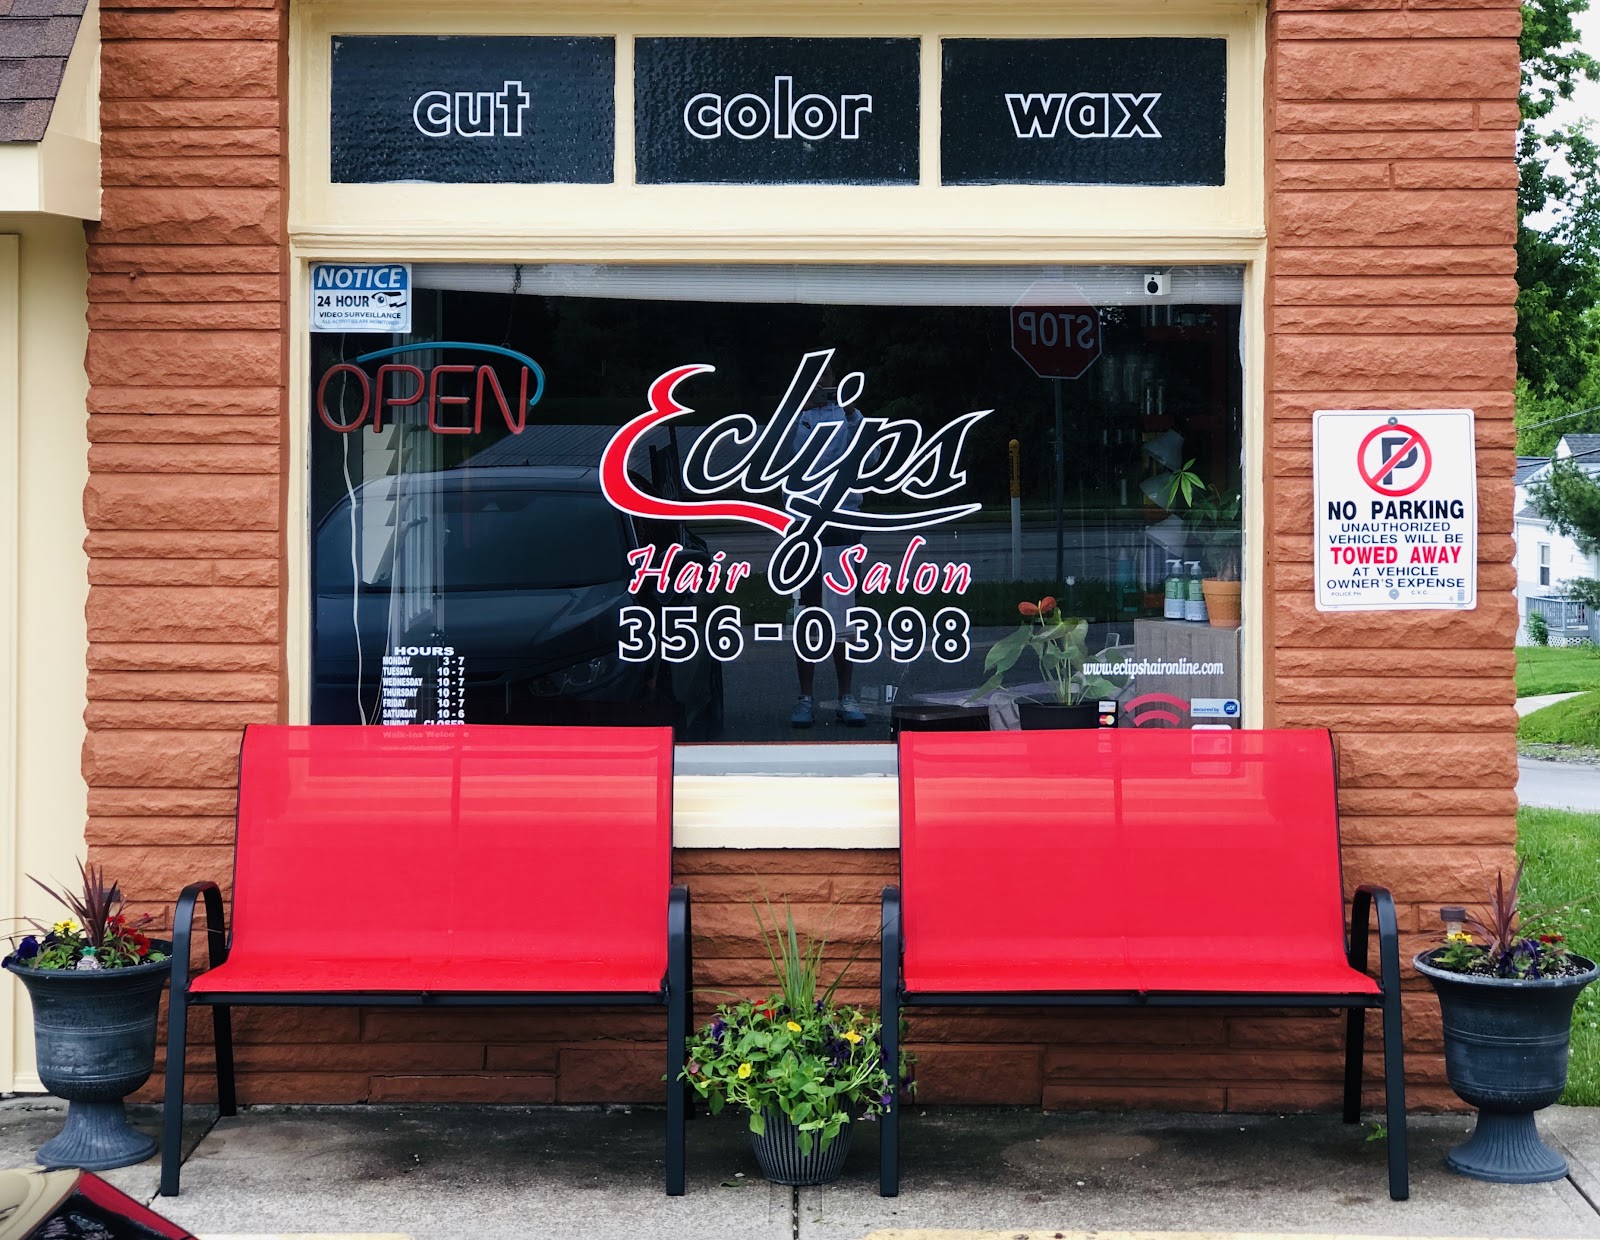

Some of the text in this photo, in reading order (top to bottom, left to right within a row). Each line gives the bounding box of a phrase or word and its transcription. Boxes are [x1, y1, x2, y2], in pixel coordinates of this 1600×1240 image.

[413, 80, 530, 137] cut
[683, 75, 872, 140] color
[1004, 91, 1163, 139] wax
[317, 267, 403, 289] NOTICE
[317, 295, 370, 308] 24 HOUR
[344, 311, 402, 319] SURVEILLANCE
[316, 363, 529, 435] OPEN
[599, 347, 995, 596] Eclips
[1327, 499, 1465, 520] NO PARKING
[1341, 522, 1451, 532] UNAUTHORIZED
[1328, 533, 1464, 544] VEHICLES WILL BE
[1330, 545, 1462, 565] TOWED AWAY
[626, 534, 972, 596] Hair Salon
[1352, 566, 1439, 577] AT VEHICLE
[1326, 577, 1465, 589] OWNER'S EXPENSE
[618, 605, 971, 663] 356-0398
[394, 646, 455, 656] HOURS
[382, 656, 411, 665] MONDAY
[382, 667, 413, 676] TUESDAY
[1083, 658, 1224, 679] www.eclipshaironline.com
[382, 677, 423, 687] WEDNESDAY
[382, 688, 418, 697] THURSDAY
[382, 699, 406, 708] FRIDAY
[382, 709, 417, 718] SATURDAY
